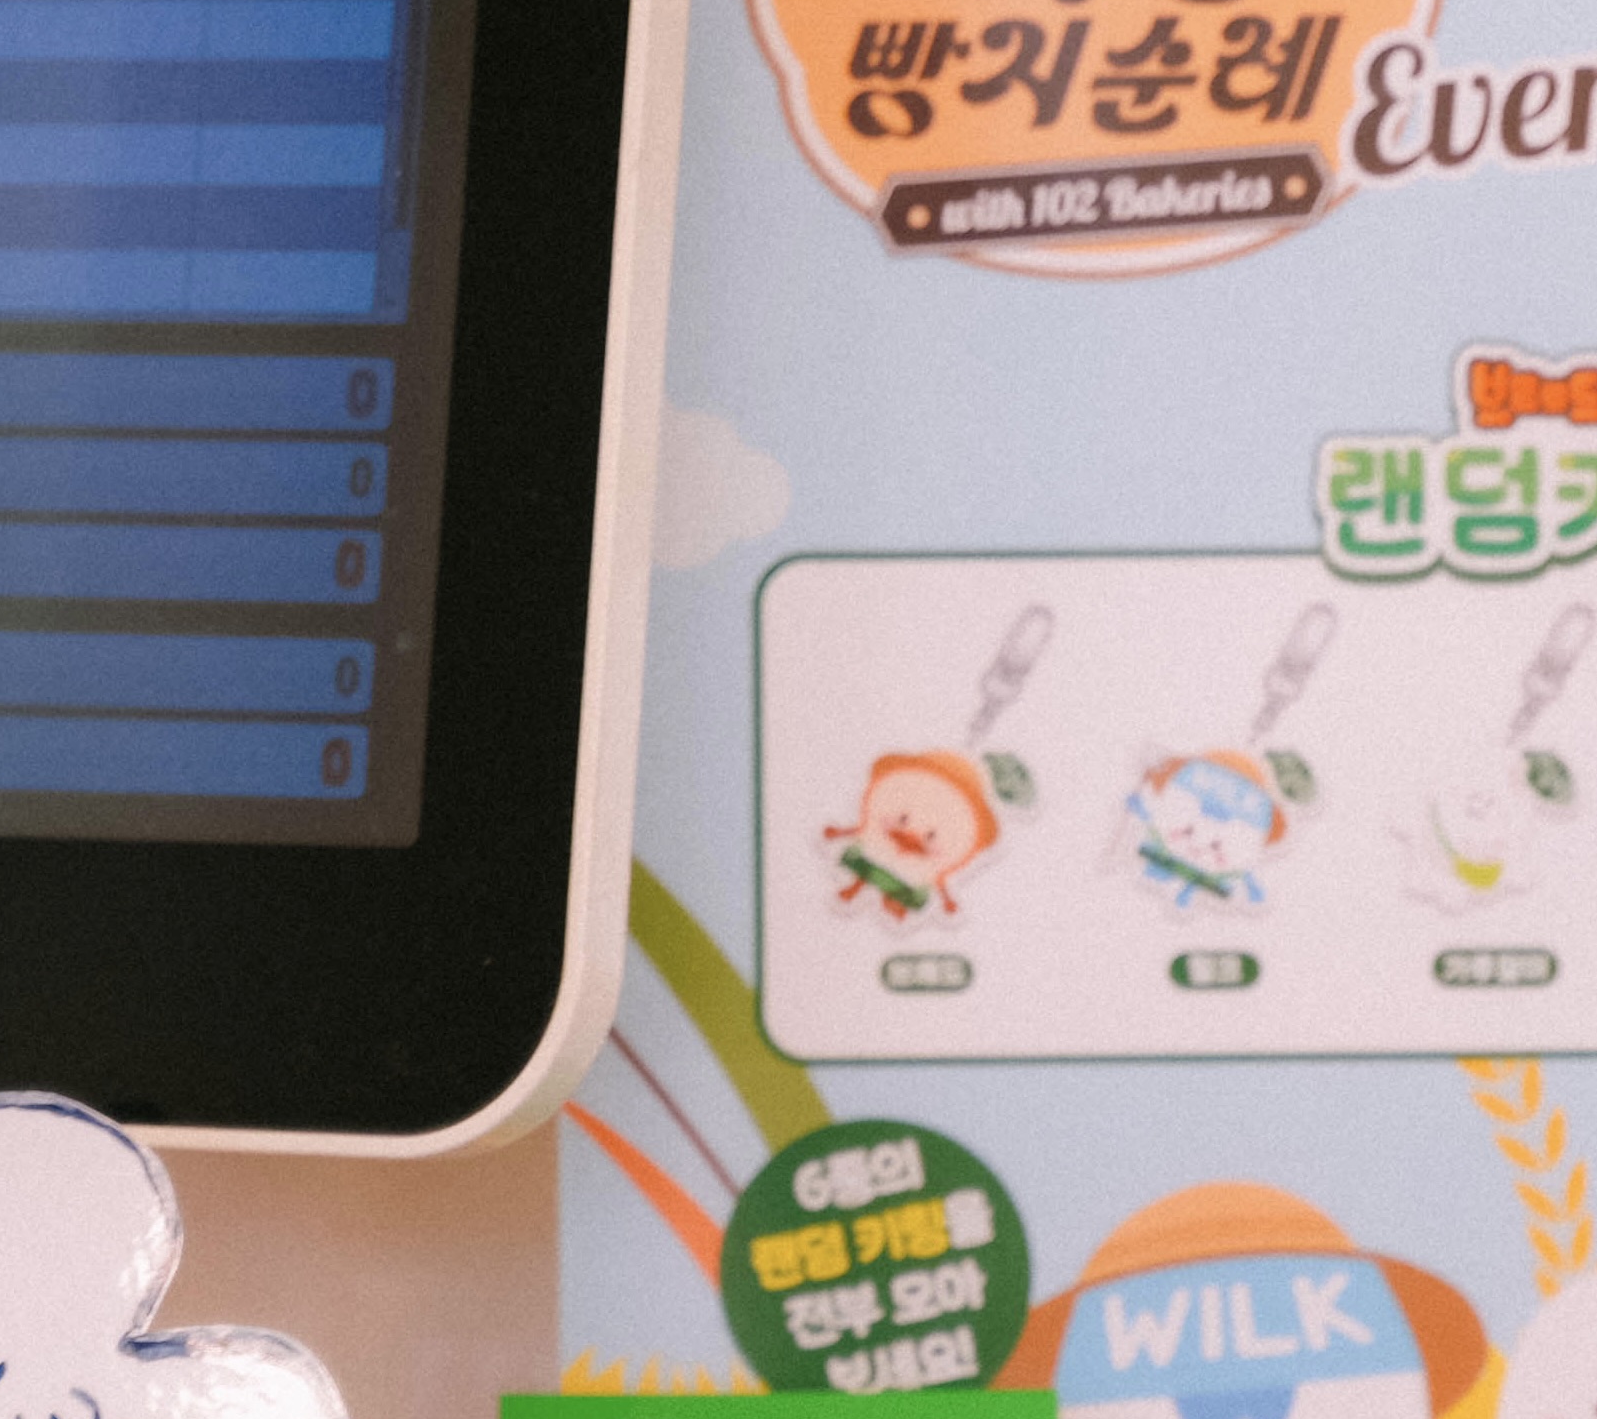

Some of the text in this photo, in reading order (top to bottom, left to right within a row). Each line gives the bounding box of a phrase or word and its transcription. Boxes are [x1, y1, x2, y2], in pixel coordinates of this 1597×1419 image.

[845, 13, 1344, 139] 빵지순례
[940, 187, 1026, 234] with
[1032, 180, 1100, 226] 102
[1102, 1271, 1374, 1373] WILK
